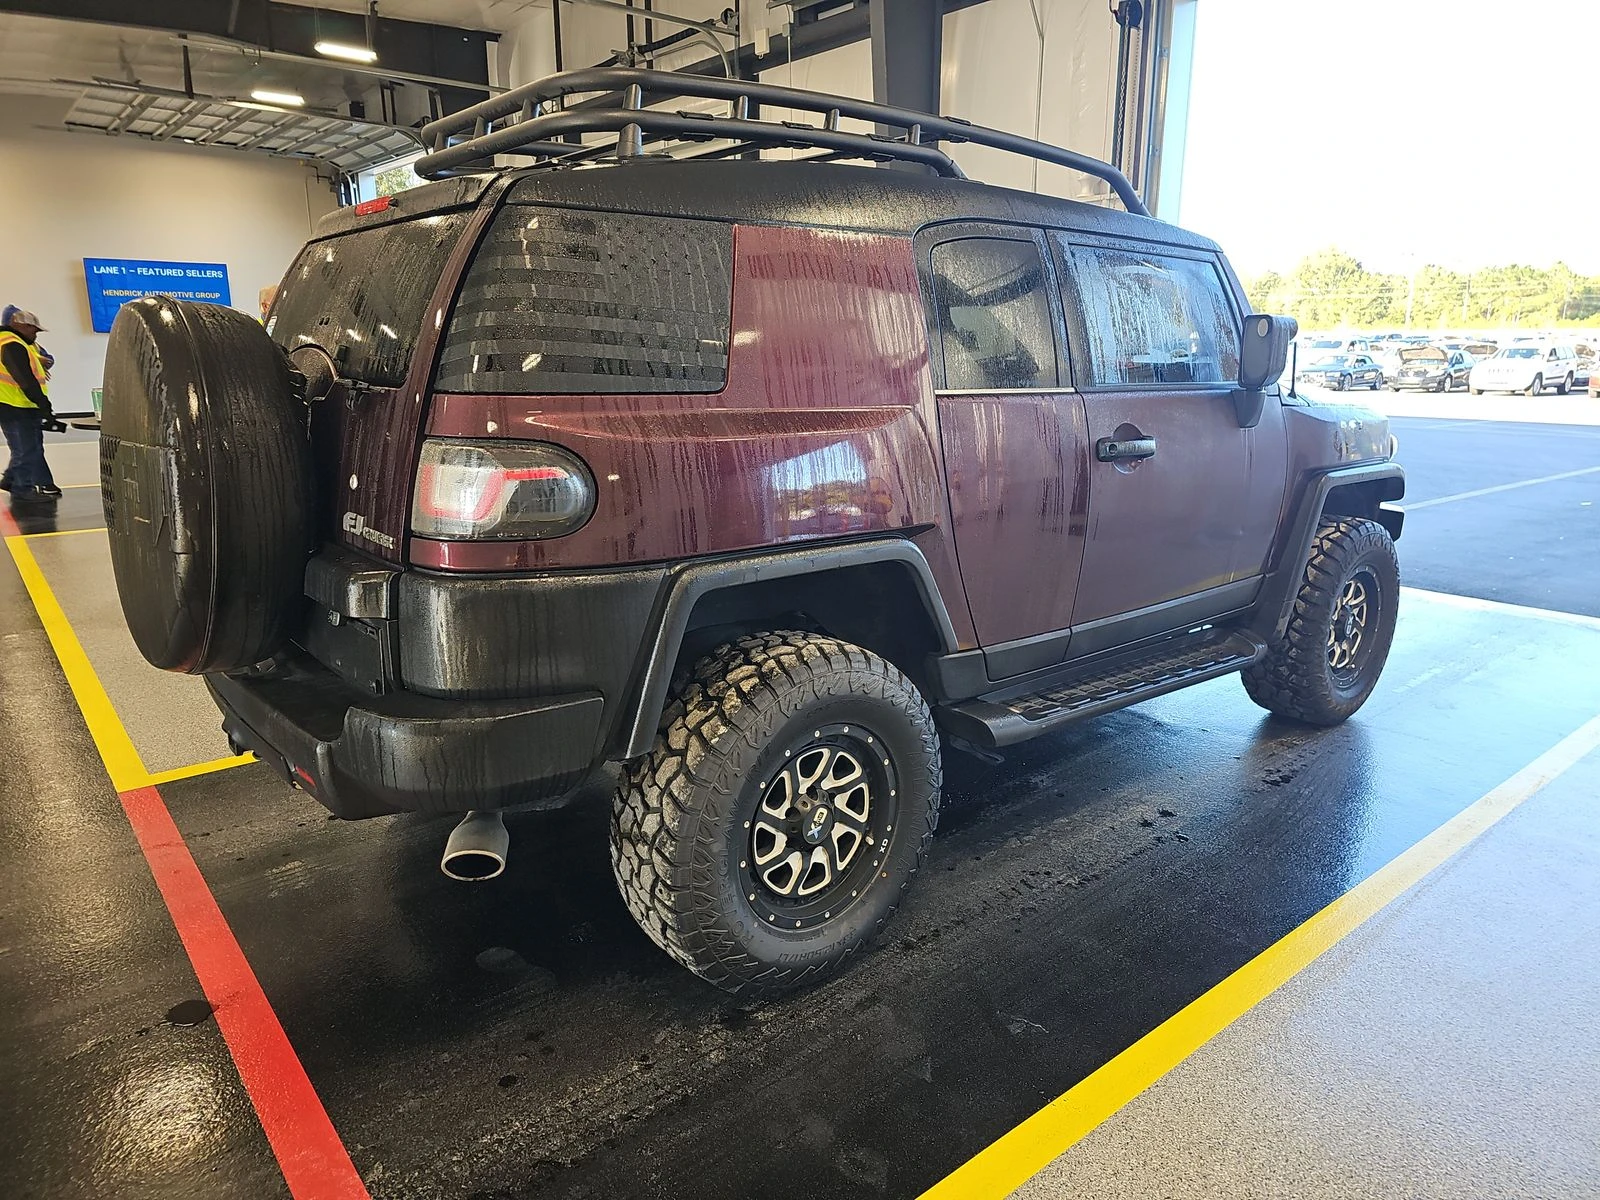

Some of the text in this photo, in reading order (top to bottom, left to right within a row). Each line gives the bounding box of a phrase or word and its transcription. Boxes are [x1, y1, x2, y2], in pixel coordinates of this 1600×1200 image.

[93, 265, 119, 275] LANE
[121, 267, 126, 275] 1
[137, 267, 184, 277] FEATURED
[185, 269, 224, 279] SELLERS
[102, 289, 143, 297] HENDRICK
[195, 291, 221, 299] GROUP
[879, 838, 889, 854] XD
